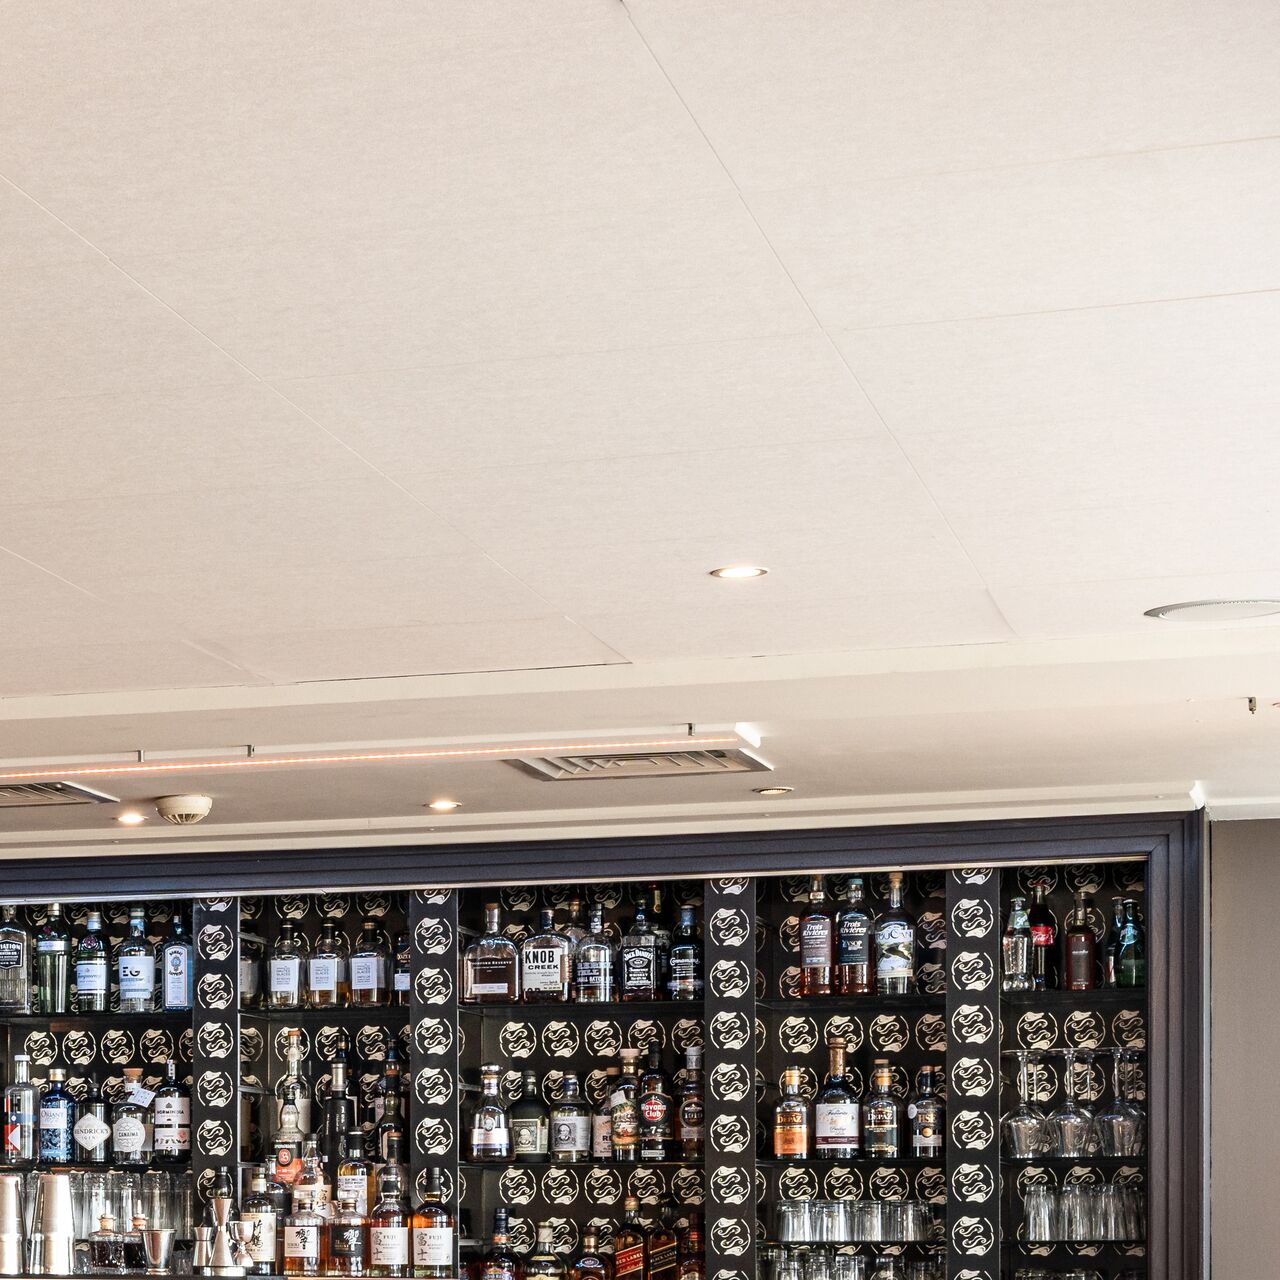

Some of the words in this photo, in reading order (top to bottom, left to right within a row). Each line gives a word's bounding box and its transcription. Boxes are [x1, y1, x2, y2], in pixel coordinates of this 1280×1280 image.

[525, 950, 555, 964] KNOB
[623, 951, 635, 961] JACK
[641, 1103, 667, 1111] Havana
[645, 1110, 662, 1118] Club
[918, 1113, 935, 1123] HSE
[615, 1257, 627, 1265] RED
[626, 1252, 643, 1262] LABEL
